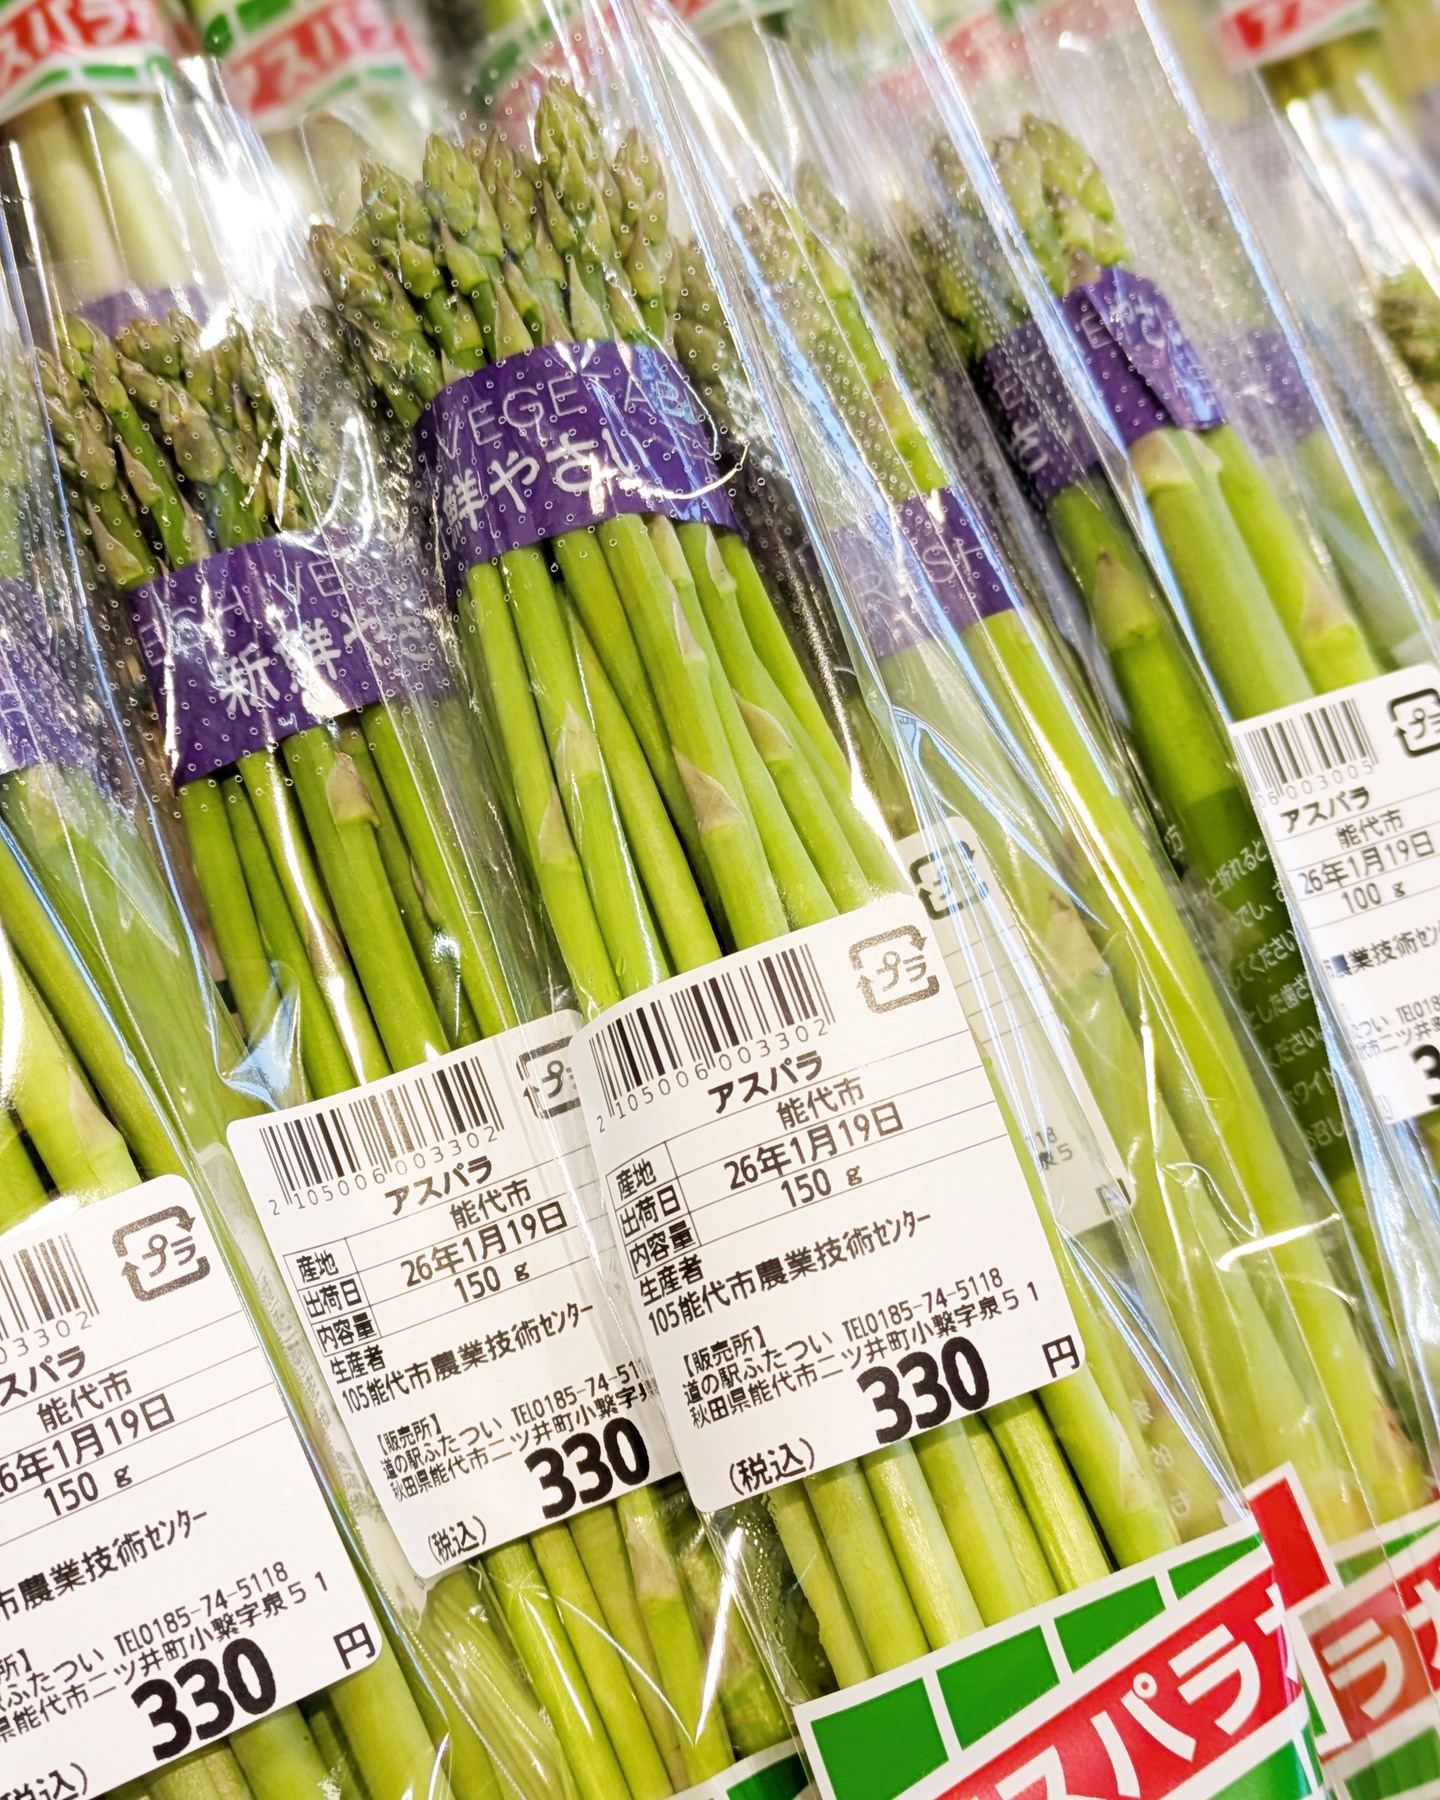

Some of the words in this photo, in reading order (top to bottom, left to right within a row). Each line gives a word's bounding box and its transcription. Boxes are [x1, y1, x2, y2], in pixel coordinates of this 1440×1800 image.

[1298, 829, 1436, 895] 26年1月19日
[1336, 808, 1405, 850] 能代市
[1341, 882, 1383, 915] 100
[1392, 880, 1407, 899] g
[879, 950, 927, 992] プラ
[708, 1050, 825, 1115] アスパラ
[616, 1157, 657, 1201] 産地
[776, 1076, 865, 1130] 能代市
[619, 1186, 683, 1238] 出荷日
[723, 1101, 905, 1191] 26年1月19日
[384, 1154, 494, 1216] アスパラ
[629, 1222, 698, 1272] 内容量
[781, 1169, 832, 1209] 150
[845, 1164, 864, 1188] g
[142, 1232, 198, 1279] プラ
[295, 1249, 339, 1284] 産地
[449, 1177, 533, 1231] 能代市
[302, 1279, 364, 1318] 出荷日
[400, 1200, 569, 1288] 26年1月19日
[315, 1311, 378, 1354] 内容量
[453, 1266, 501, 1304] 150
[514, 1260, 531, 1283] g
[638, 1254, 704, 1307] 生産者
[329, 1344, 386, 1386] 生産者
[682, 1324, 768, 1378] 【販売所】
[682, 1330, 834, 1406] 道の駅ふたつい
[37, 1368, 134, 1434] 能代市
[374, 1412, 445, 1455] 【販売所】
[728, 1438, 816, 1496] (税込)
[857, 1336, 990, 1445] 330
[1042, 1334, 1081, 1378] 円
[380, 1415, 503, 1482] 道の駅ふたつい
[43, 1470, 99, 1518] 150
[114, 1464, 134, 1489] g
[426, 1513, 488, 1566] (税込)
[524, 1416, 650, 1520] 330
[0, 1646, 105, 1714] ふたつい
[131, 1637, 278, 1761] 330
[333, 1621, 377, 1671] 円
